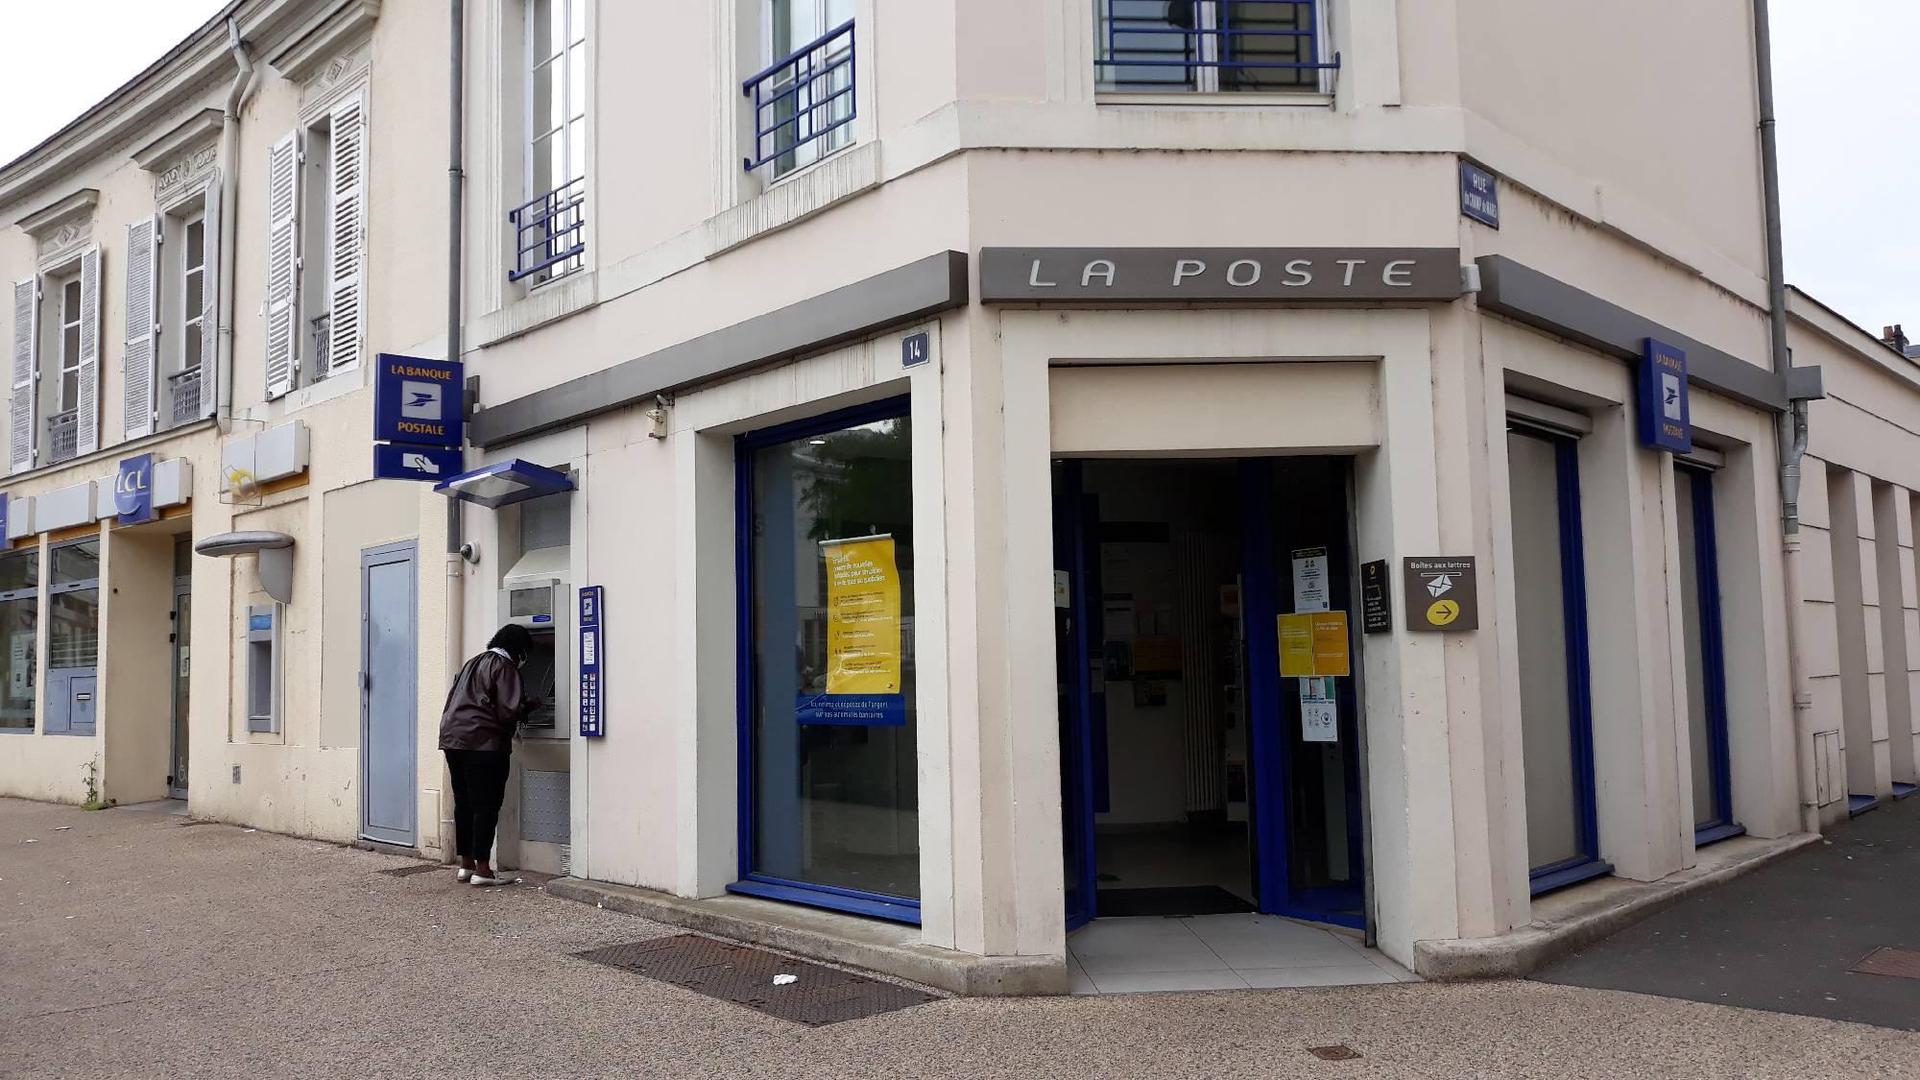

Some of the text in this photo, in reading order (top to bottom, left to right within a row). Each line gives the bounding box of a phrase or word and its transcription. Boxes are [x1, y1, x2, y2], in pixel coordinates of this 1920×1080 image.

[1473, 173, 1487, 193] RUE
[1469, 192, 1481, 210] CHAMP
[1028, 259, 1417, 287] LA POSTE
[909, 340, 921, 360] 14
[391, 364, 453, 380] LA BANQUE
[397, 421, 445, 436] POSTALE
[116, 469, 147, 494] LCL
[1447, 561, 1471, 569] lettres
